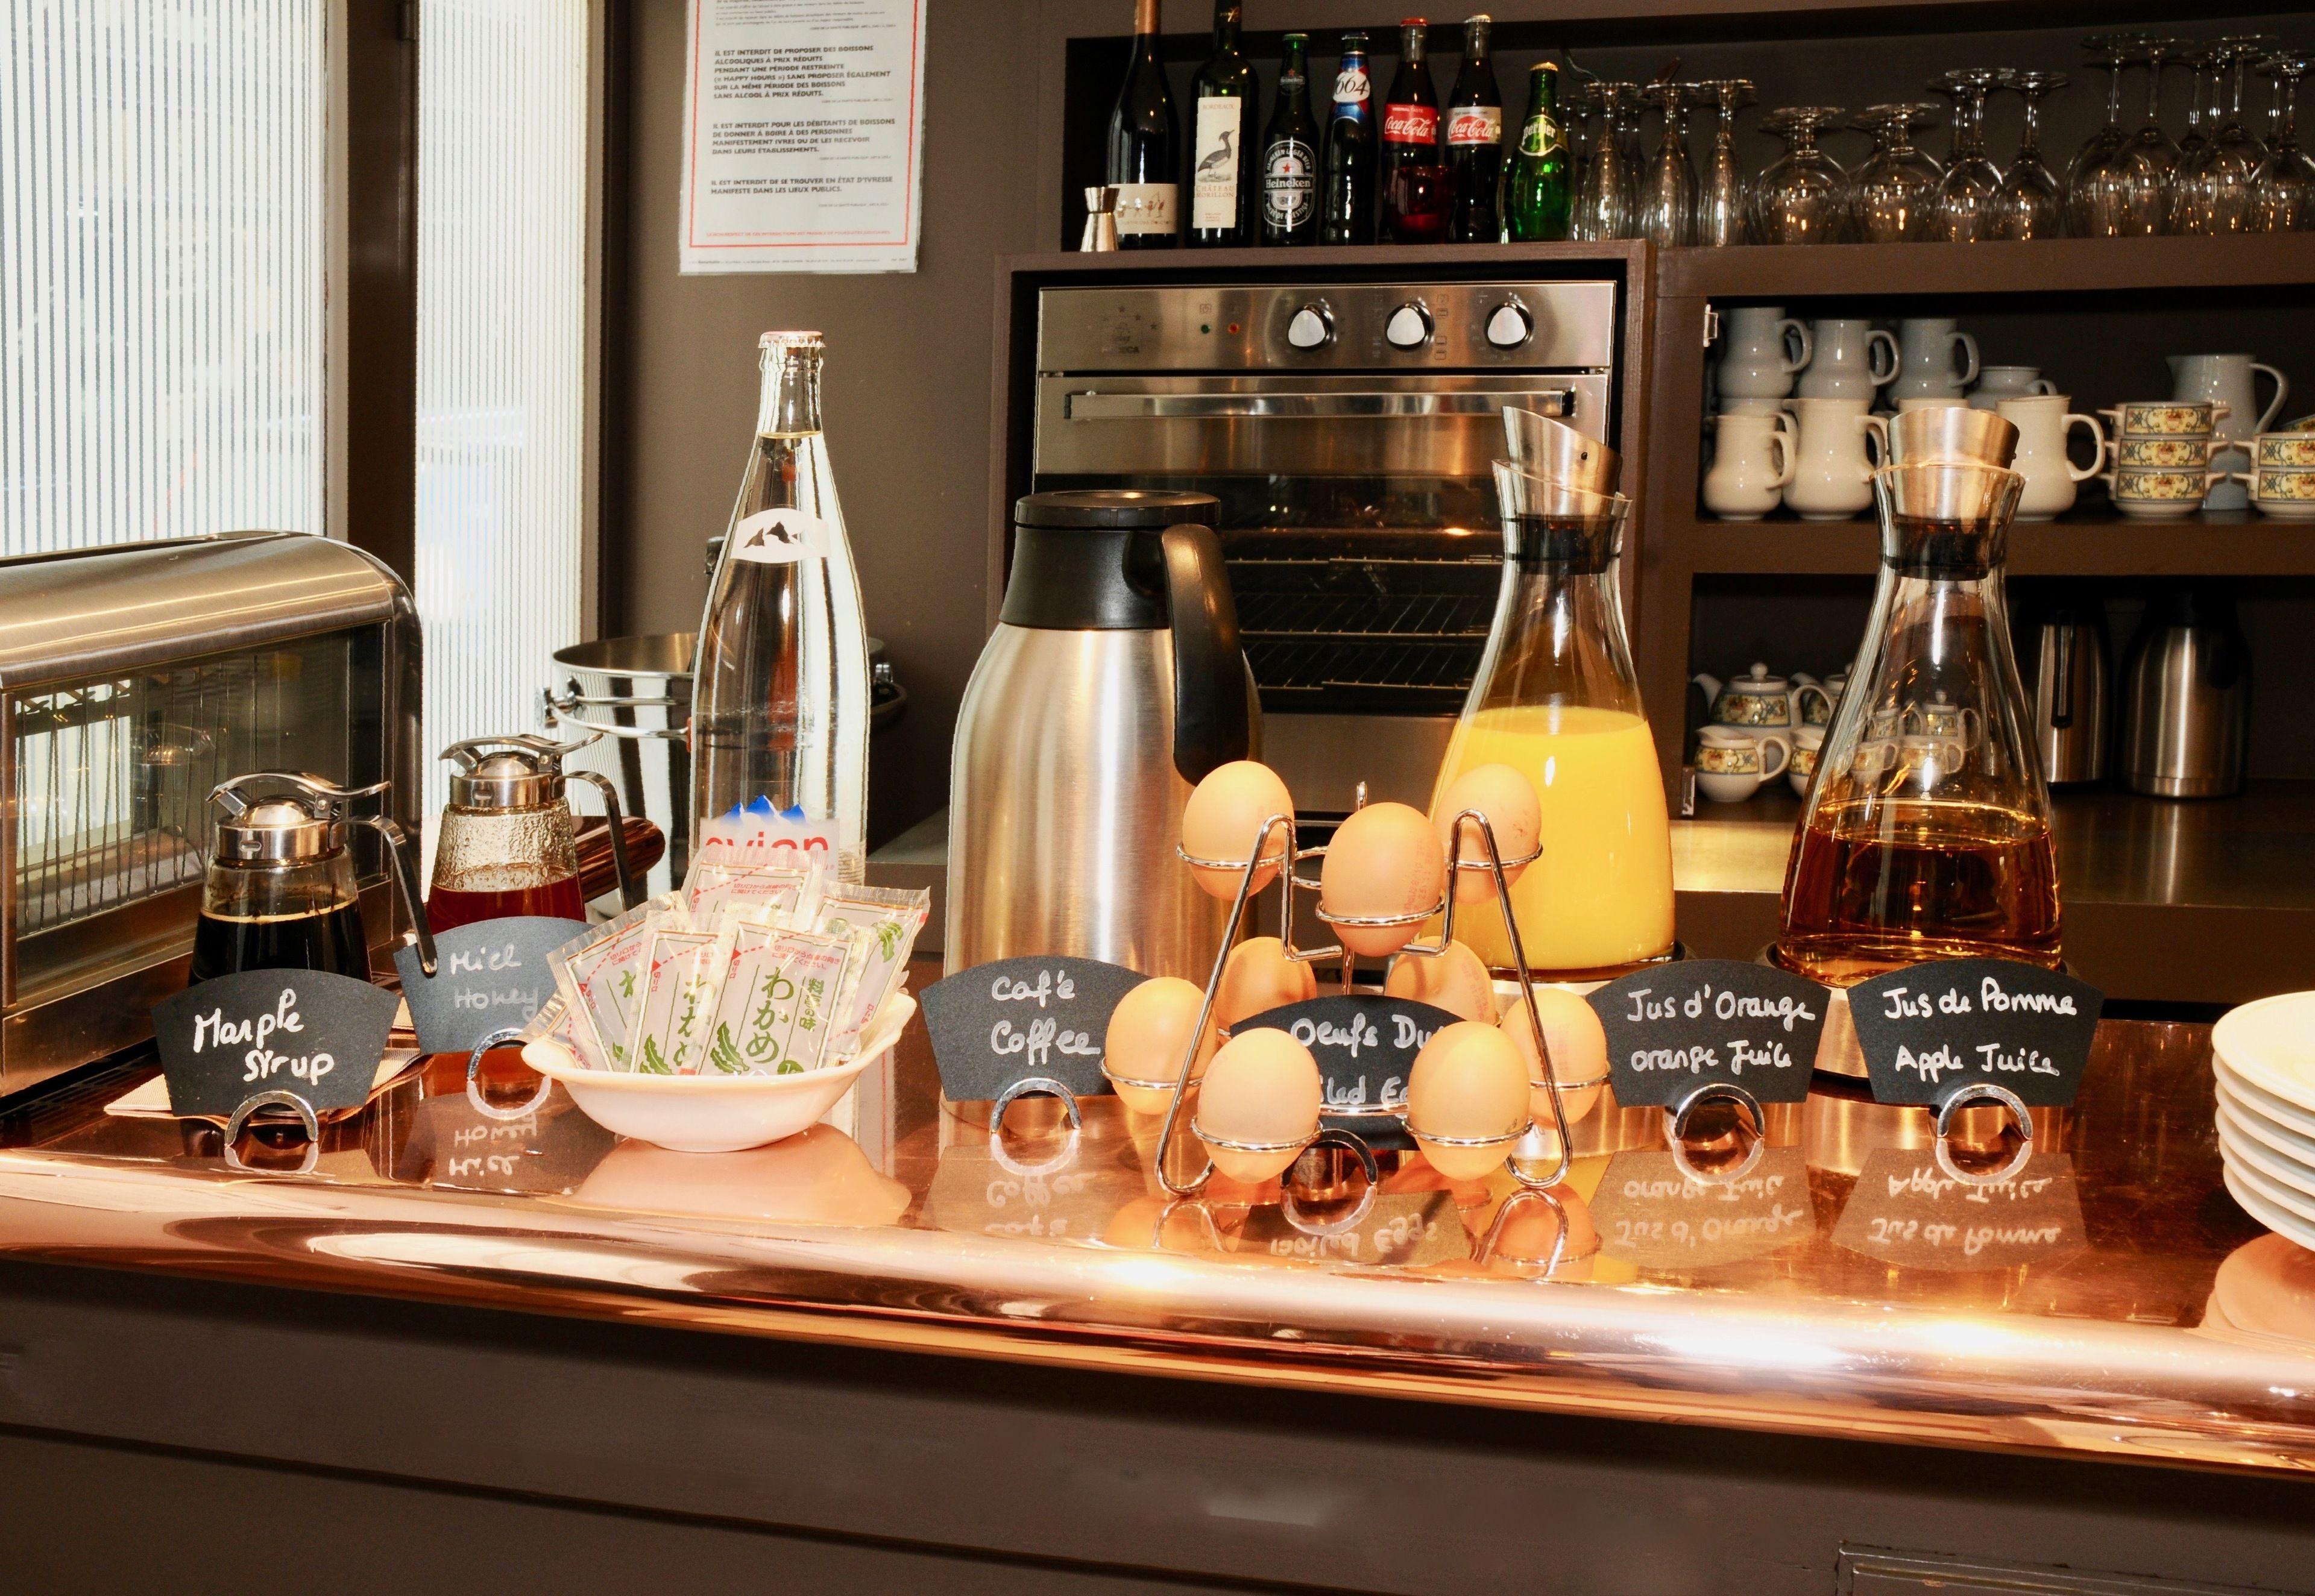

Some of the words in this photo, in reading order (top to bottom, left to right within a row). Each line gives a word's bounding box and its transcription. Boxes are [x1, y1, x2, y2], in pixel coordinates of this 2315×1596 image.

[846, 70, 890, 78] ÉGALEMENT
[1333, 75, 1369, 95] 664
[758, 145, 819, 154] ÉTABLISSEMENTS.
[1287, 149, 1304, 158] LGER
[1266, 178, 1311, 189] Heineken
[450, 943, 521, 975] Miel
[454, 987, 539, 1020] Honey
[1627, 987, 1675, 1022] Jus
[1883, 987, 1933, 1020] Jus
[1938, 987, 1972, 1014] de
[1980, 976, 2077, 1016] Pomme
[745, 966, 795, 1064] わかめ
[991, 1017, 1101, 1066] Coffee
[1290, 1012, 1379, 1058] Oeufs
[1391, 1014, 1446, 1049] Du
[1895, 1045, 1964, 1084] Apple
